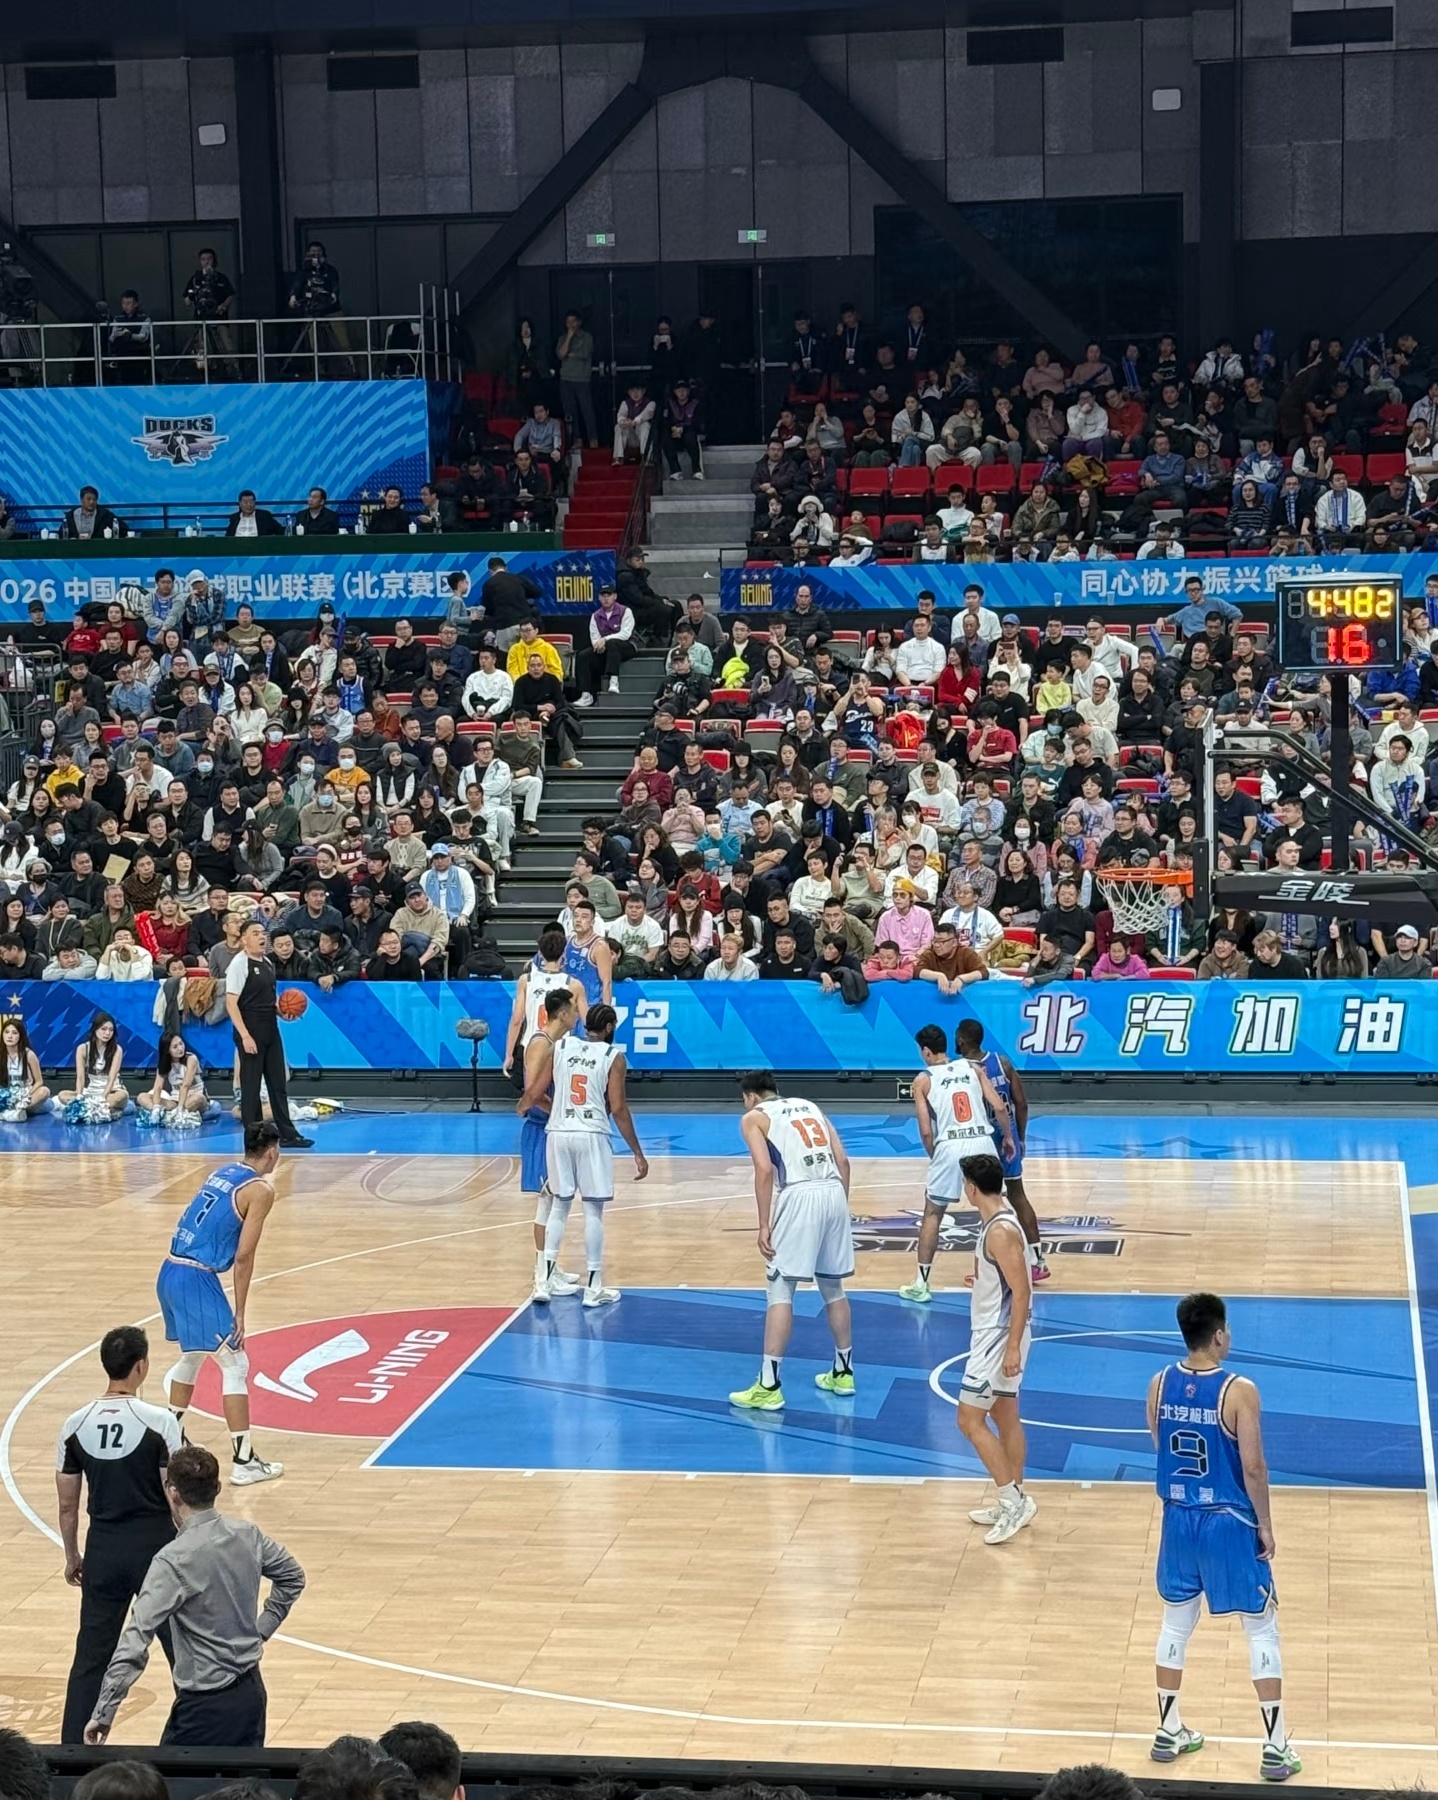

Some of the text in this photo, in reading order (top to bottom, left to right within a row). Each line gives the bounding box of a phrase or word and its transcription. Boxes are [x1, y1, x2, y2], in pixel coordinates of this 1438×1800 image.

[556, 576, 594, 603] BEIJING
[740, 583, 773, 607] BEIJING
[1328, 623, 1371, 664] 16
[1276, 880, 1355, 902] 金陵
[1020, 994, 1405, 1054] 北汽加油
[570, 1074, 588, 1106] 5
[952, 1091, 973, 1123] 0
[791, 1117, 828, 1149] 13
[338, 1329, 450, 1404] LI-NING
[97, 1423, 123, 1449] 72
[1170, 1429, 1209, 1478] 9
